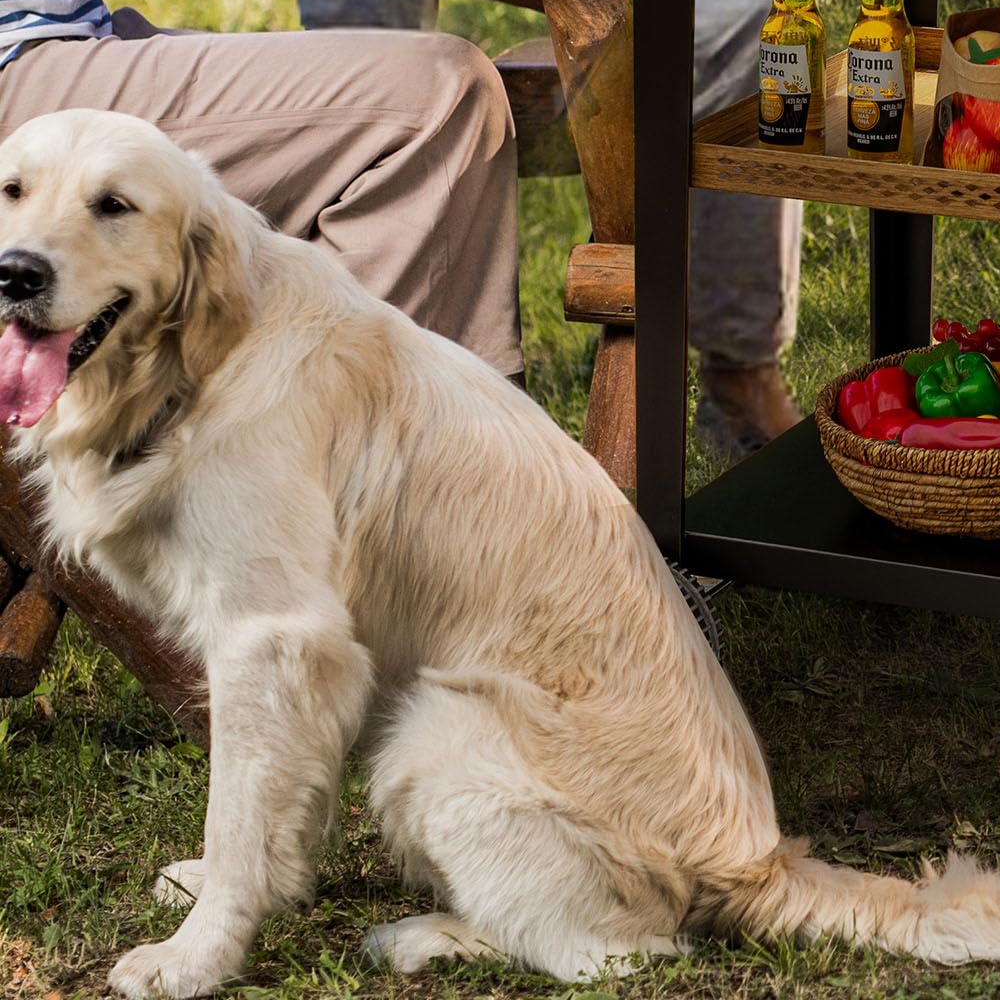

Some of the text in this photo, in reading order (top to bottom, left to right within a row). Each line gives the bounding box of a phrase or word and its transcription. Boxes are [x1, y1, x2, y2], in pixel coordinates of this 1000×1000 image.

[760, 48, 799, 65] orona
[848, 50, 893, 71] Corona
[760, 62, 785, 78] Extra
[852, 69, 881, 84] Extra
